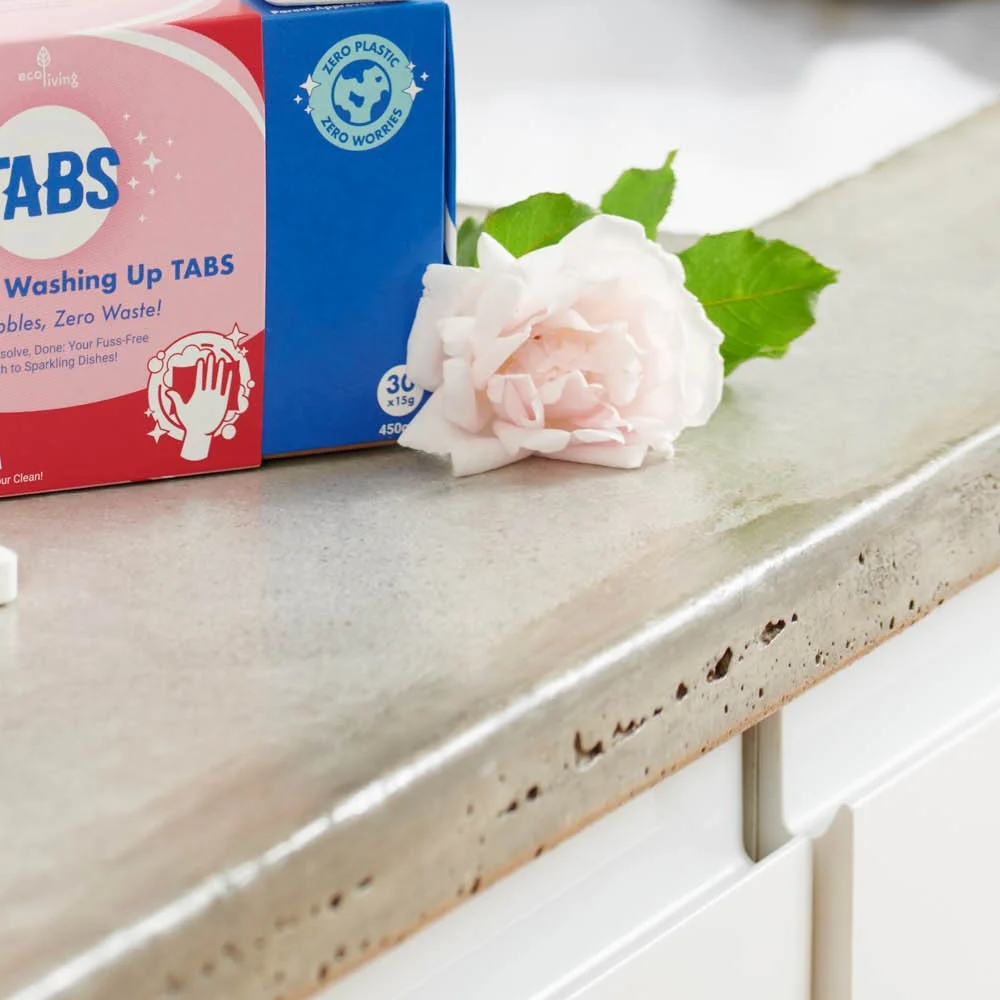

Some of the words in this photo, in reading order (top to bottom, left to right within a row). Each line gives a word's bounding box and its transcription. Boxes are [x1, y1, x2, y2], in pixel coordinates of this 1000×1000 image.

[322, 45, 351, 75] ZERO
[355, 40, 400, 68] PLASTIC
[321, 115, 349, 144] ZERO
[352, 107, 403, 146] WORRIES
[4, 269, 117, 299] Washing
[127, 264, 162, 290] Up
[171, 253, 235, 281] TABS
[54, 310, 95, 328] Zero
[102, 299, 163, 322] Waste!
[67, 338, 94, 351] Your
[96, 333, 150, 348] Fuss-Free
[10, 363, 22, 374] to
[24, 357, 75, 375] Sparkling
[78, 351, 119, 367] Dishes!
[386, 373, 415, 394] 30
[13, 471, 44, 484] Clean!
